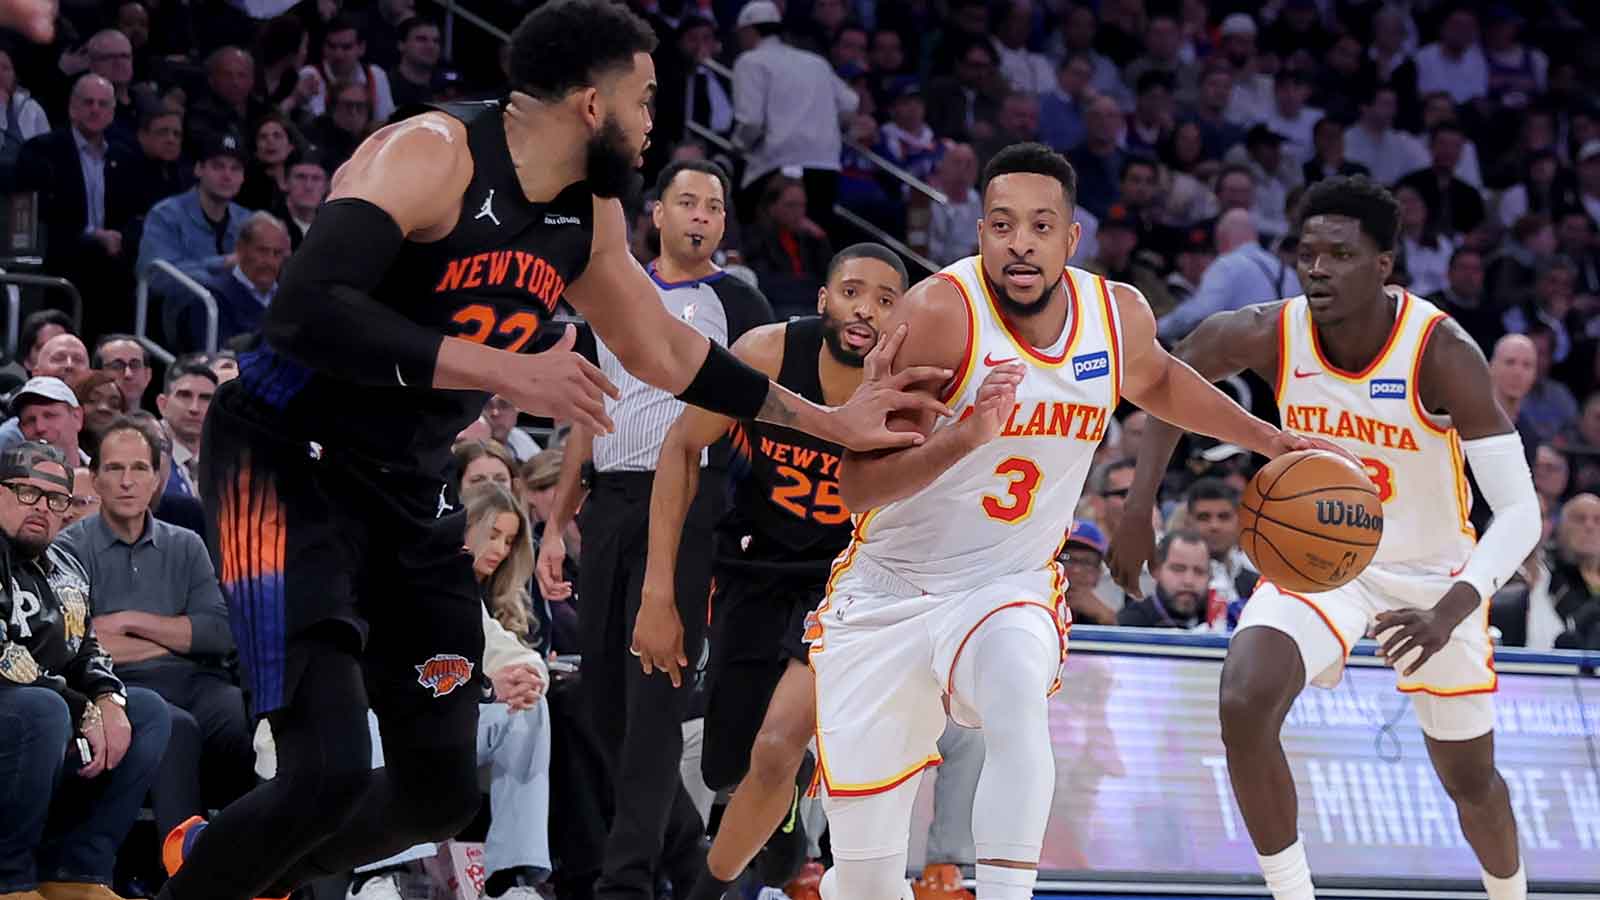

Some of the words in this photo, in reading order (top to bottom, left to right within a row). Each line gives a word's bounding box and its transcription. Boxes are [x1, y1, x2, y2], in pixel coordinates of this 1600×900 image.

[435, 251, 513, 292] NEW
[1075, 358, 1107, 377] paze
[1372, 383, 1405, 396] paze
[959, 402, 1107, 441] LANTA
[1285, 404, 1419, 451] ATLANTA
[761, 437, 818, 469] NEW
[771, 464, 851, 524] 25
[982, 456, 1042, 524] 3
[1307, 760, 1561, 850] MINIARE
